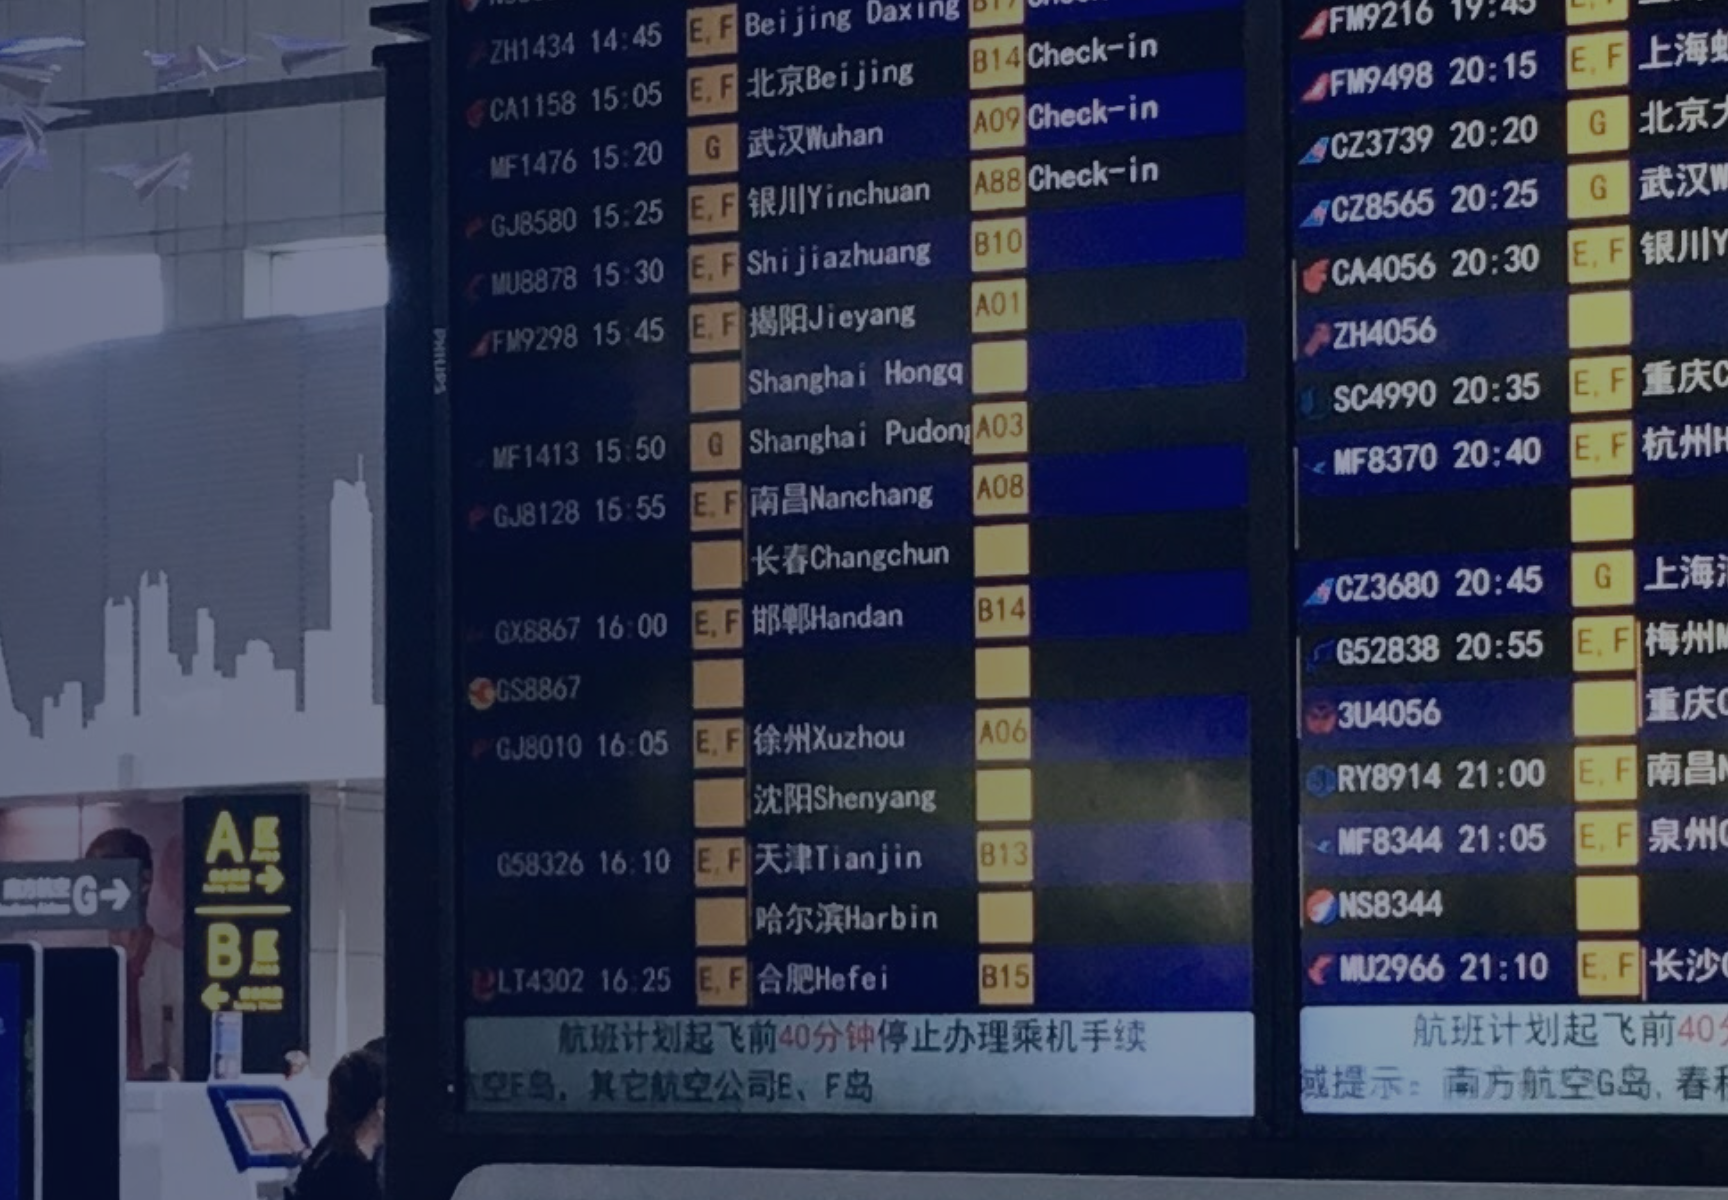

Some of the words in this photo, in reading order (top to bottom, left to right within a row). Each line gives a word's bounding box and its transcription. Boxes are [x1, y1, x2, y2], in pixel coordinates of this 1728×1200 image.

[592, 22, 662, 52] 14:45
[745, 9, 851, 36] Beijing
[1330, 0, 1433, 33] FM9216
[491, 91, 576, 122] CA1158
[592, 81, 662, 111] 15:05
[747, 63, 913, 97] 北京Beijing
[973, 46, 1020, 73] B14
[1028, 37, 1157, 68] Check-in
[1331, 61, 1433, 96] FM9498
[1450, 50, 1537, 85] 20:15
[491, 149, 577, 178] MF1476
[593, 140, 662, 169] 15:20
[706, 135, 720, 159] G
[748, 123, 883, 158] 武汉Wuhan
[974, 107, 1019, 133] A09
[1028, 99, 1158, 129] Check-in
[1332, 125, 1433, 159] CZ3739
[1450, 115, 1537, 149] 20:20
[1590, 110, 1605, 135] G
[492, 207, 576, 237] GJ8580
[594, 199, 663, 228] 15:25
[748, 181, 929, 217] 银川Yinchuan
[1029, 161, 1158, 191] Check-in
[1332, 188, 1434, 222] CZ8565
[1451, 179, 1538, 212] 20:25
[1590, 175, 1607, 200] G
[492, 266, 577, 294] MU8878
[594, 258, 663, 287] 15:30
[747, 242, 931, 275] Shijiazhuang
[975, 229, 1022, 256] B10
[1332, 252, 1436, 286] CA4056
[1452, 244, 1539, 277] 20:30
[493, 324, 578, 352] FM9298
[594, 317, 664, 345] 15:45
[750, 304, 915, 337] 揭阳Jieyang
[976, 292, 1017, 316] A01
[1334, 316, 1437, 349] ZH4056
[749, 365, 865, 394] Shanghai
[1334, 380, 1436, 412] SC4990
[1453, 373, 1540, 404] 20:35
[493, 442, 578, 468] MF1413
[597, 435, 665, 462] 15:50
[708, 432, 722, 457] G
[750, 425, 865, 454] Shanghai
[976, 413, 1023, 439] A03
[1334, 443, 1437, 475] MF8370
[1453, 437, 1541, 468] 20:40
[494, 500, 579, 527] GJ8128
[751, 482, 933, 517] 南昌Nanchang
[977, 474, 1023, 499] A08
[752, 541, 949, 575] 长春Changchun
[1336, 571, 1439, 601] CZ3680
[1455, 566, 1543, 596] 20:45
[1595, 564, 1611, 588] G
[598, 613, 667, 639] 16:00
[752, 603, 902, 635] 邯郸Handan
[979, 598, 1025, 622] B14
[1457, 630, 1543, 660] 20:55
[1339, 698, 1441, 728] 3U4056
[600, 730, 668, 756] 16:05
[754, 723, 904, 755] 徐州Xuzhou
[980, 720, 1026, 743] A06
[1338, 762, 1441, 791] RY8914
[1458, 759, 1545, 788] 21:00
[755, 784, 936, 814] 沈阳Shenyang
[601, 848, 670, 874] 16:10
[756, 843, 922, 874] 天津Tianjin
[981, 843, 1027, 866] B13
[1339, 826, 1442, 855] MF8344
[1459, 824, 1546, 852] 21:05
[72, 874, 99, 916] G
[1339, 890, 1443, 918] NS8344
[757, 903, 937, 934] 哈尔滨Harbin
[207, 921, 242, 978] B
[1341, 954, 1444, 981] MU2966
[1460, 952, 1548, 981] 21:10
[602, 967, 670, 992] 16:25
[759, 963, 886, 994] 合肥Hefei
[982, 965, 1029, 988] B15
